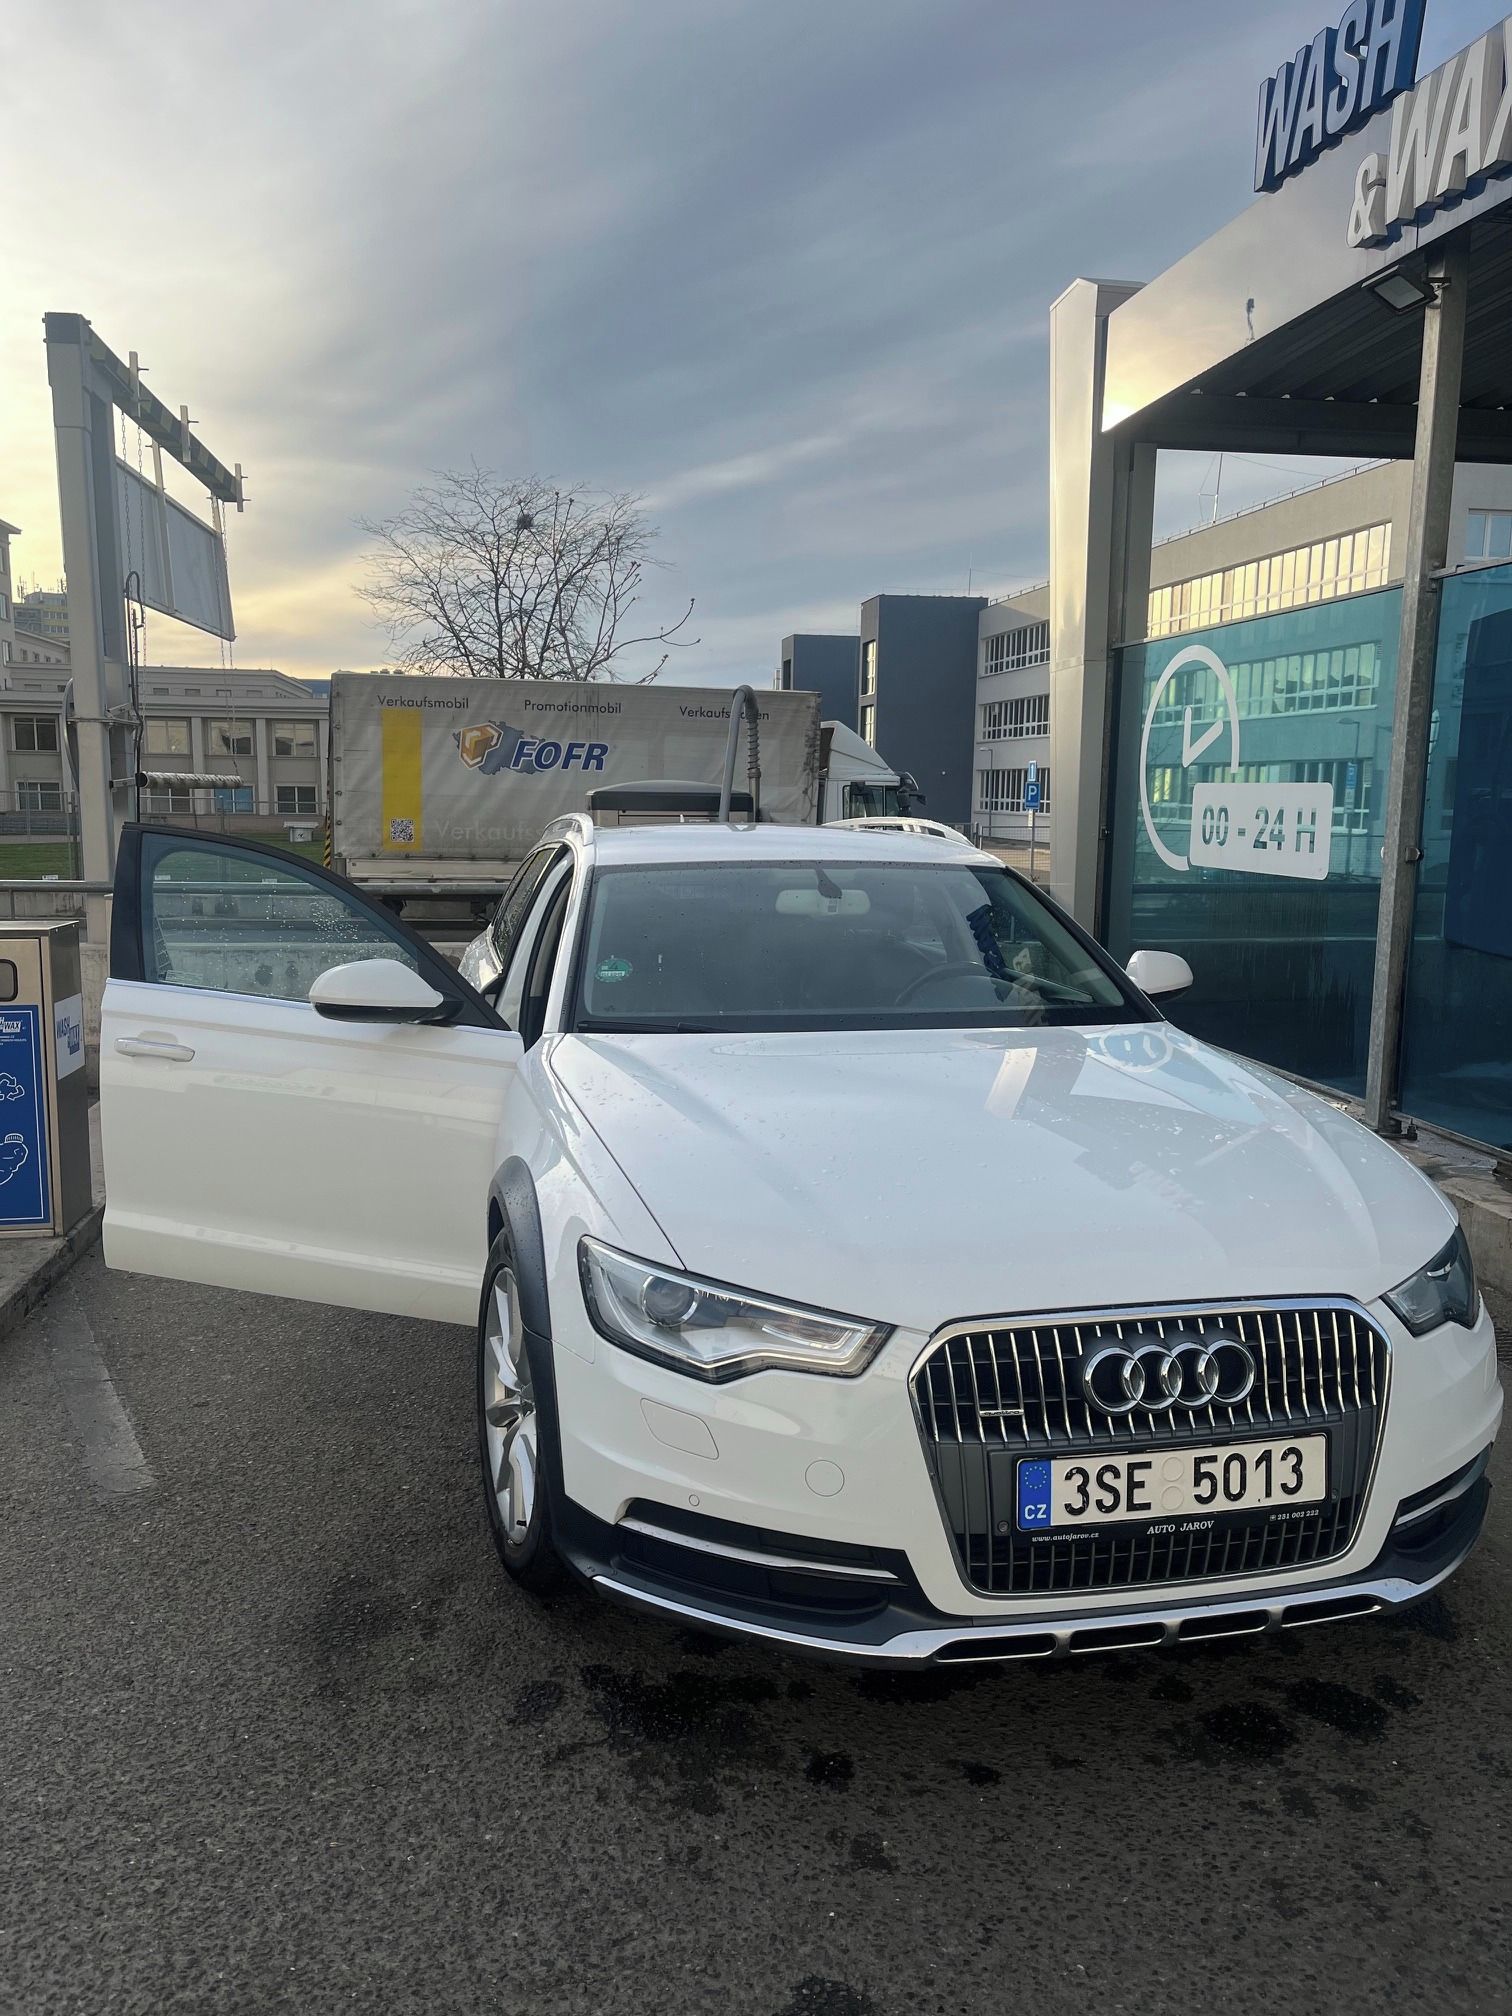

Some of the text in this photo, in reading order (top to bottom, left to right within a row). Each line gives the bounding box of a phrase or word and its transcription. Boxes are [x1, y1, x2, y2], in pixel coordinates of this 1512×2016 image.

[1254, 0, 1414, 193] WASH
[1346, 153, 1385, 248] &
[377, 695, 469, 709] Verkaufsmobil
[524, 700, 622, 714] Promotionmobil
[511, 739, 609, 771] FOFR
[1028, 785, 1037, 800] P
[1202, 804, 1229, 847] 00
[1253, 806, 1286, 851] 24
[1295, 807, 1317, 854] H
[4, 1021, 20, 1031] WAX
[1064, 1446, 1304, 1516] 3SE 5013
[1024, 1504, 1047, 1520] CZ
[1147, 1520, 1214, 1535] AUTO JAROV
[1032, 1532, 1099, 1543] www.autojarov.cz
